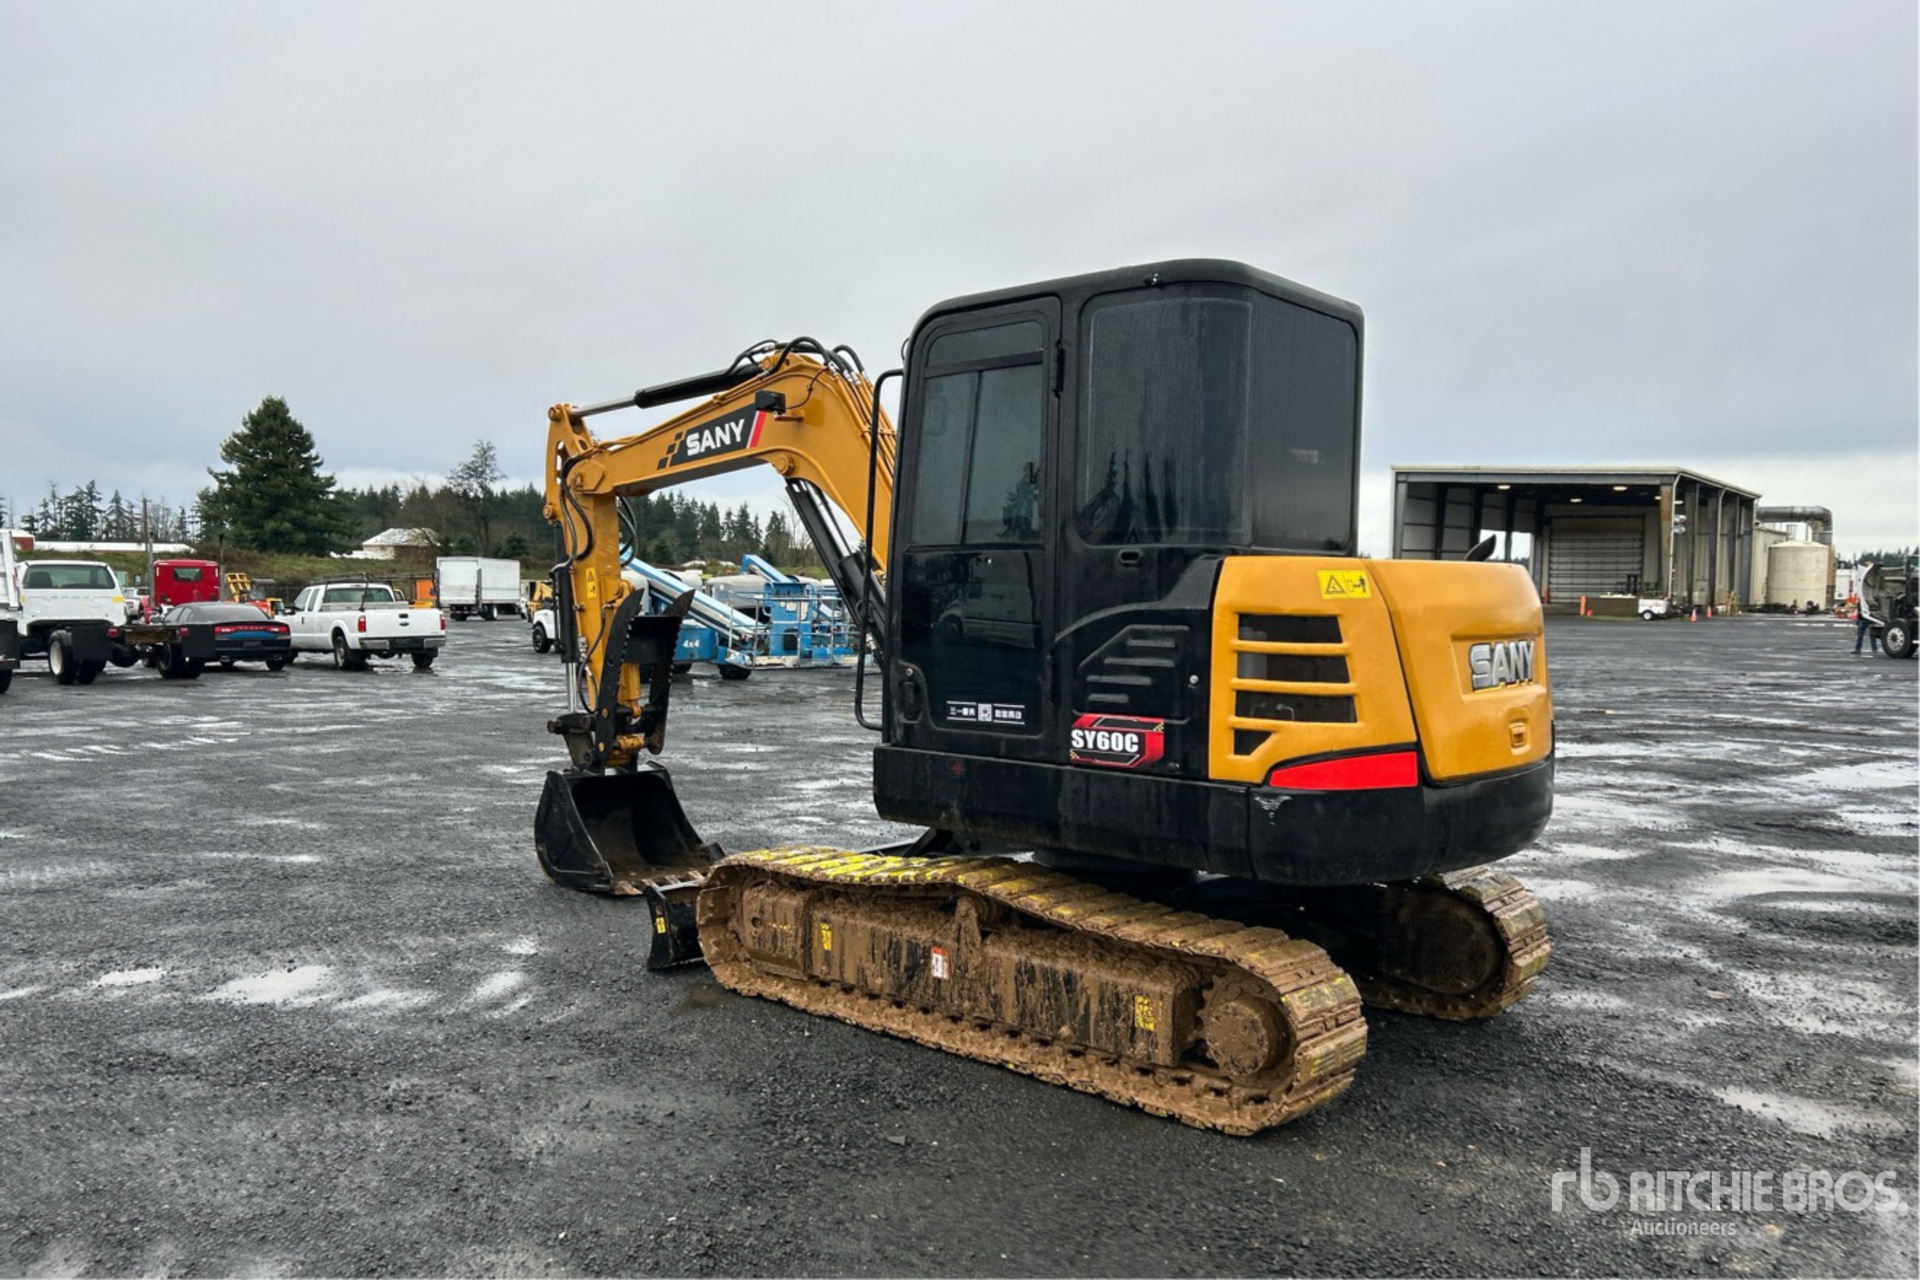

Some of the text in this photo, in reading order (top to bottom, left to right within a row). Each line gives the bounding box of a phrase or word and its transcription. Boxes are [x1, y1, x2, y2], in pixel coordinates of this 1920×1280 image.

[686, 419, 745, 457] SANY
[682, 639, 700, 648] 4x4
[1469, 640, 1535, 690] SANY
[1071, 729, 1139, 753] SY60C
